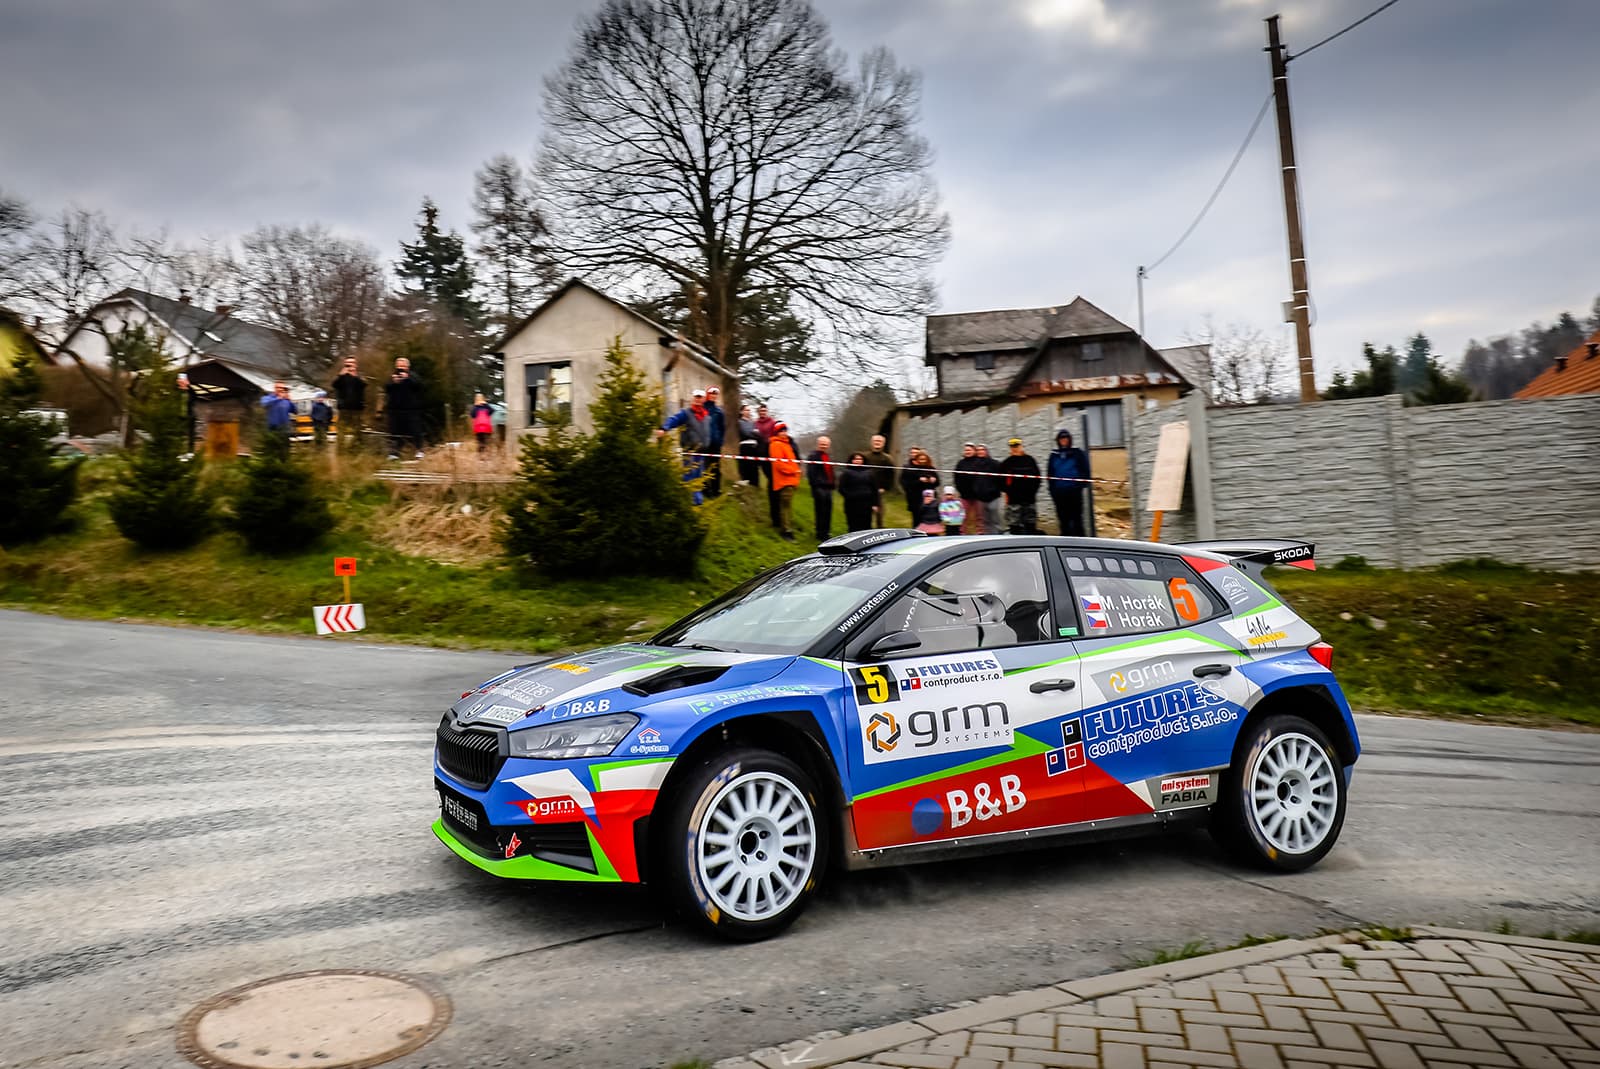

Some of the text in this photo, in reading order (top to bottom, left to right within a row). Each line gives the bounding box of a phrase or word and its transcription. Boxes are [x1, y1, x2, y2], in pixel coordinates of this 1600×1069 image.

[837, 581, 899, 633] www.rexteam.cz
[1101, 595, 1165, 610] M. Horák
[1168, 577, 1200, 621] 5
[1119, 612, 1164, 628] Horák
[918, 659, 998, 677] FUTURES
[1127, 660, 1176, 689] grm
[859, 666, 889, 703] 5
[923, 672, 1003, 693] contproduct s.r.o.
[570, 699, 610, 716] B&B
[1084, 680, 1229, 740] FUTURES
[907, 701, 1010, 747] grm
[944, 729, 1010, 744] SYSTEMS
[1088, 707, 1239, 760] contproduct s.r.o.
[539, 799, 575, 816] grm
[945, 774, 1027, 829] B&B
[1161, 790, 1208, 805] FABIA
